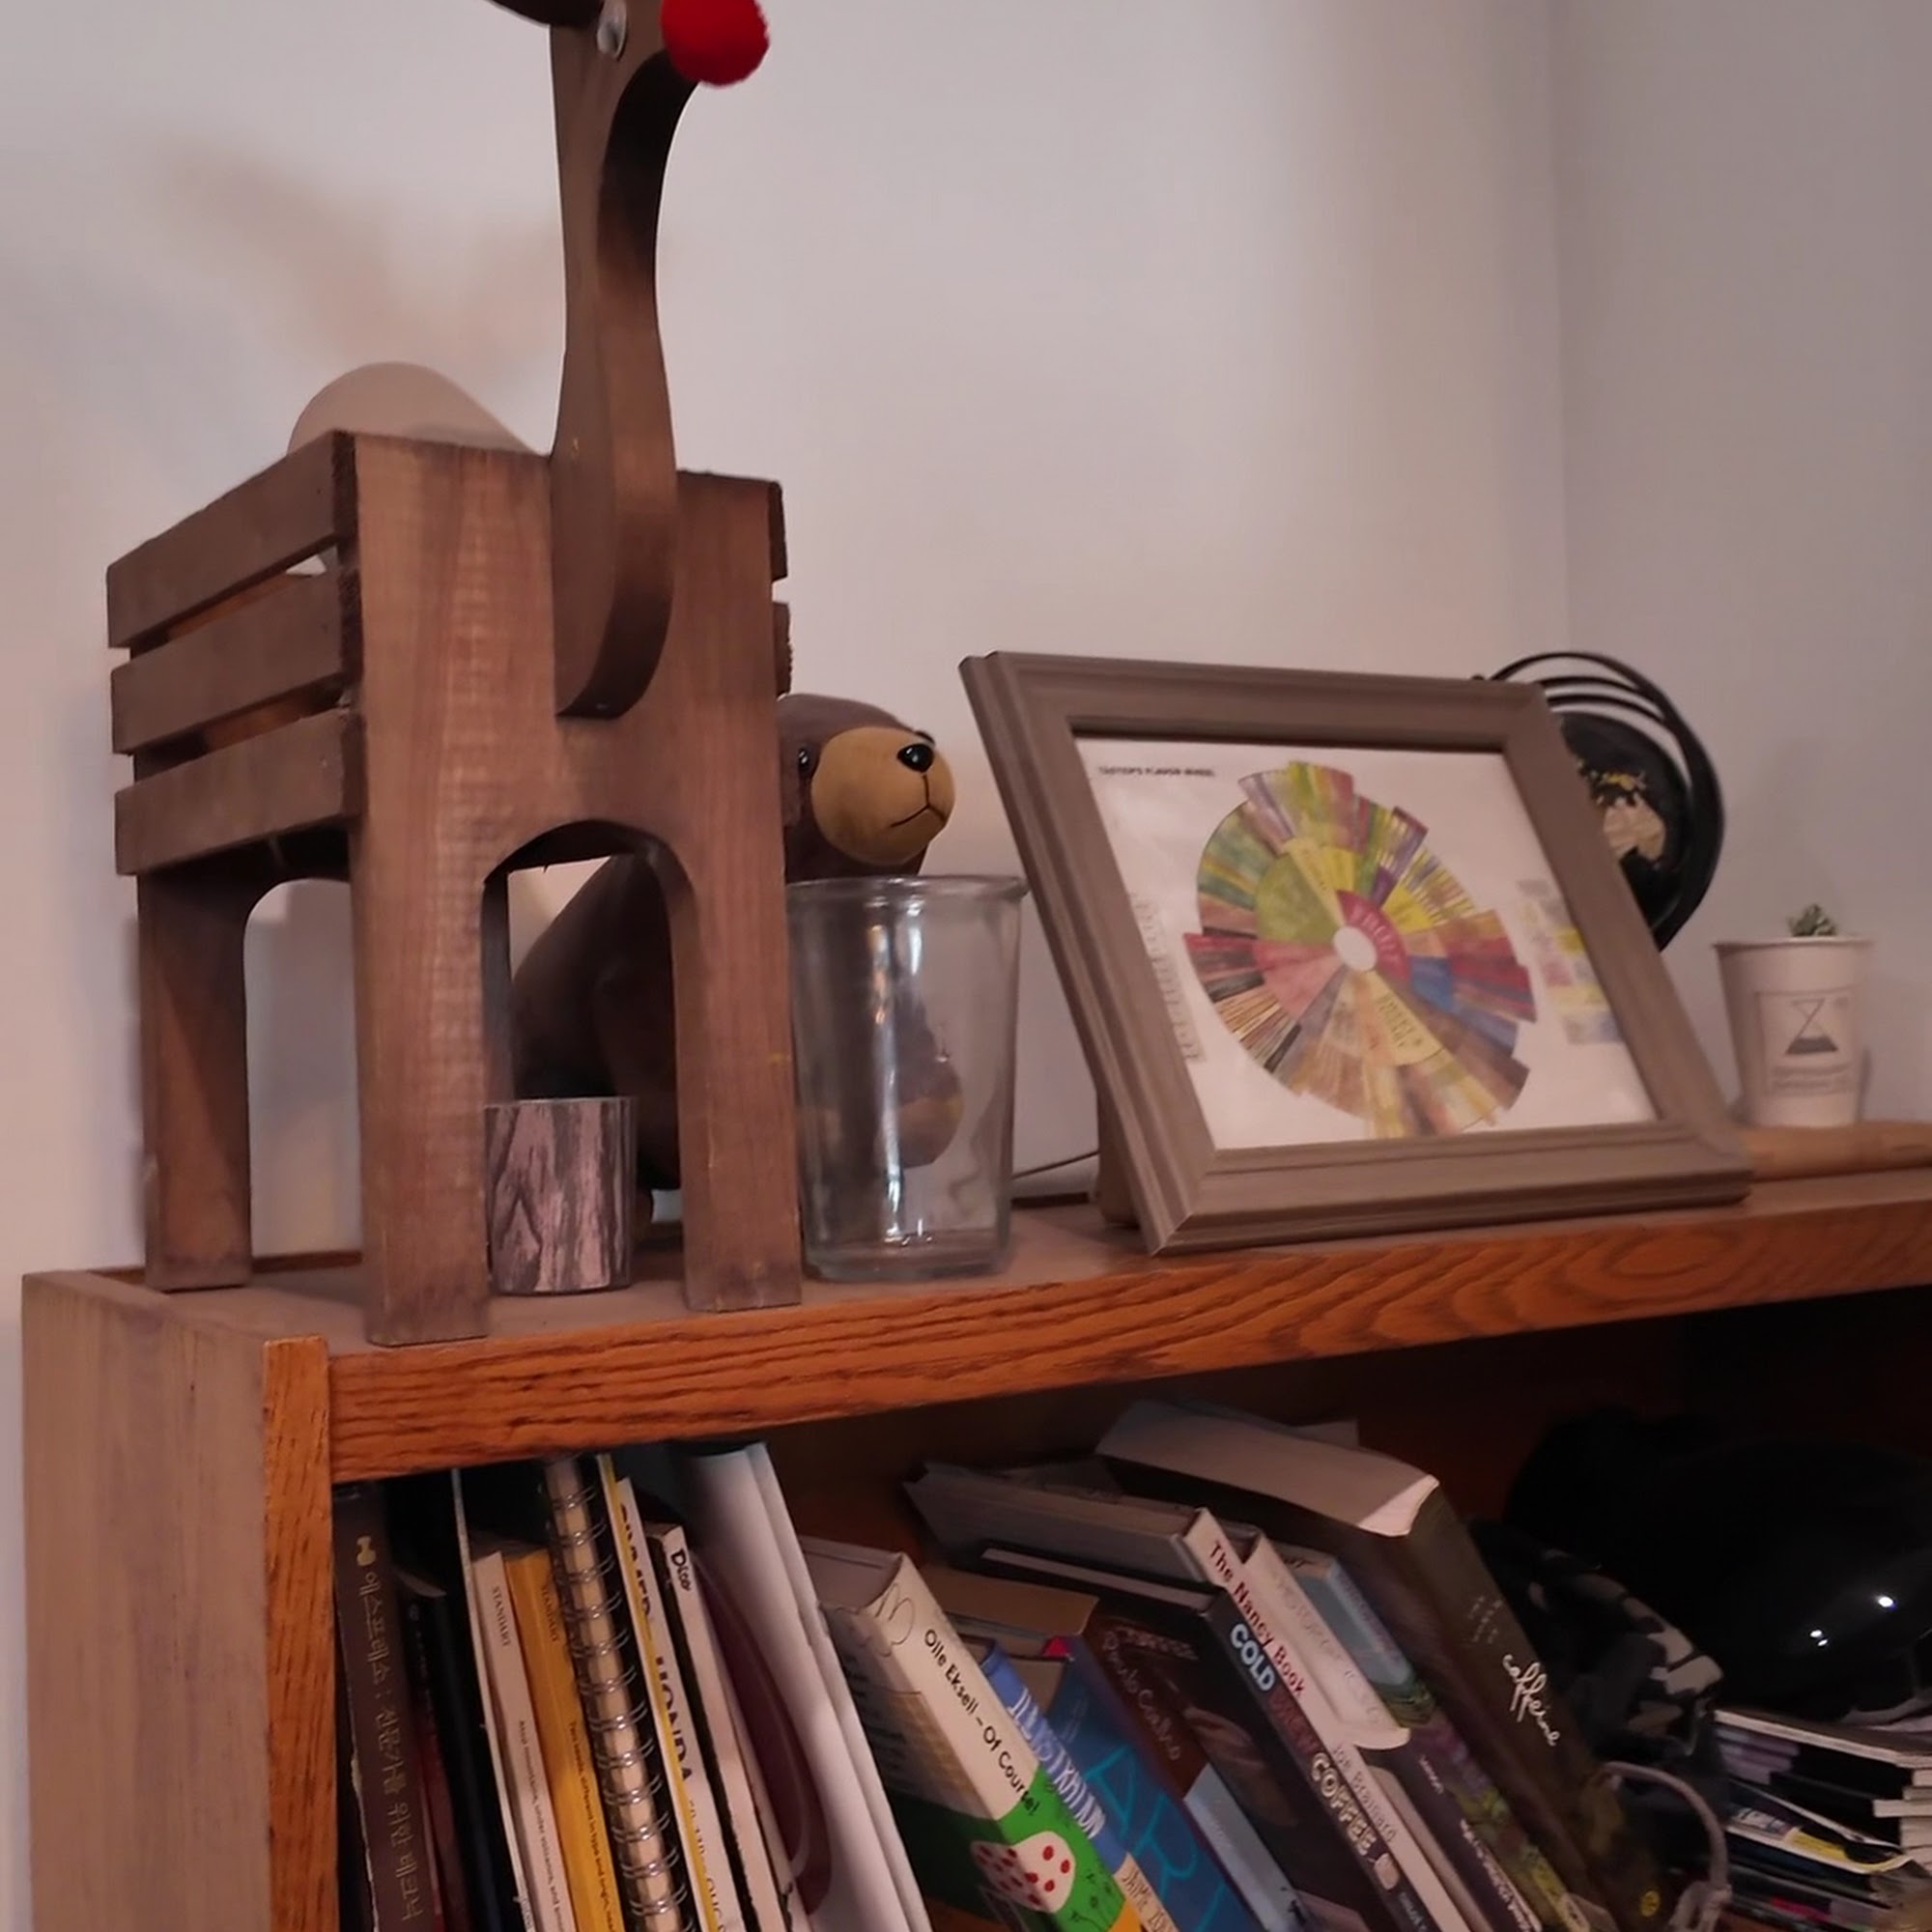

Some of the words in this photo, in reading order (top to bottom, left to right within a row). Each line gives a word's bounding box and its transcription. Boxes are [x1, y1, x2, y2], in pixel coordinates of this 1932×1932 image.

[358, 1571, 390, 1686] 에스프레소
[493, 1585, 511, 1647] STANDART
[1210, 1540, 1233, 1582] The
[1234, 1581, 1274, 1648] Nancy
[1274, 1646, 1304, 1696] Book
[924, 1629, 948, 1667] Olle
[945, 1663, 979, 1715] Eksell
[983, 1725, 1003, 1752] Of
[998, 1750, 1040, 1815] Course!
[1230, 1623, 1275, 1691] COLD
[1311, 1751, 1378, 1856] COFFEE
